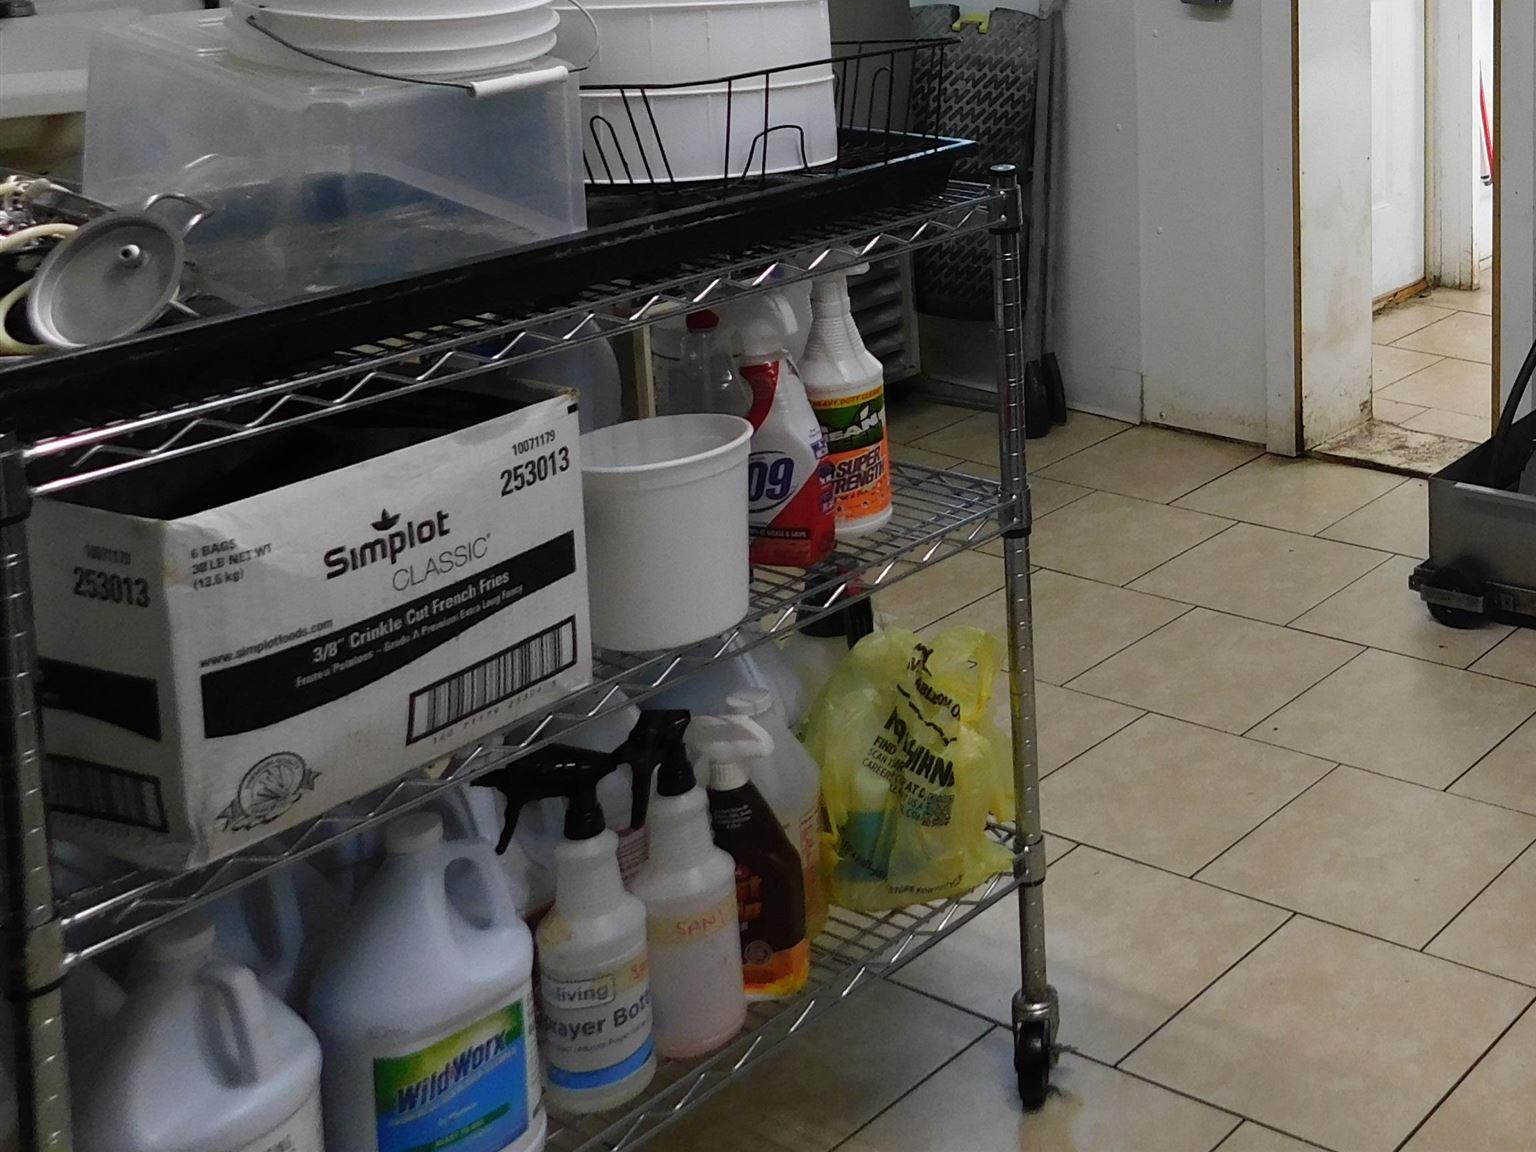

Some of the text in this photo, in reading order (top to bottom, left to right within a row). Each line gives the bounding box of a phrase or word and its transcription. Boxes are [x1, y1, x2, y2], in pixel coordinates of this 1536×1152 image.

[511, 429, 556, 456] 10071179
[836, 446, 882, 478] SUPER
[500, 445, 571, 497] 253013
[202, 539, 237, 556] BAGS
[209, 557, 226, 570] LB
[228, 551, 252, 565] NET
[255, 543, 272, 557] WT
[323, 509, 450, 580] Simplot
[73, 566, 150, 608] 253013
[224, 568, 245, 583] kg)
[350, 618, 402, 648] Crinkle
[406, 606, 429, 625] Cut
[432, 584, 476, 615] French
[479, 571, 510, 594] Fries
[200, 619, 333, 668] www.simplotfoods.com
[397, 1029, 507, 1114] WildWorx
